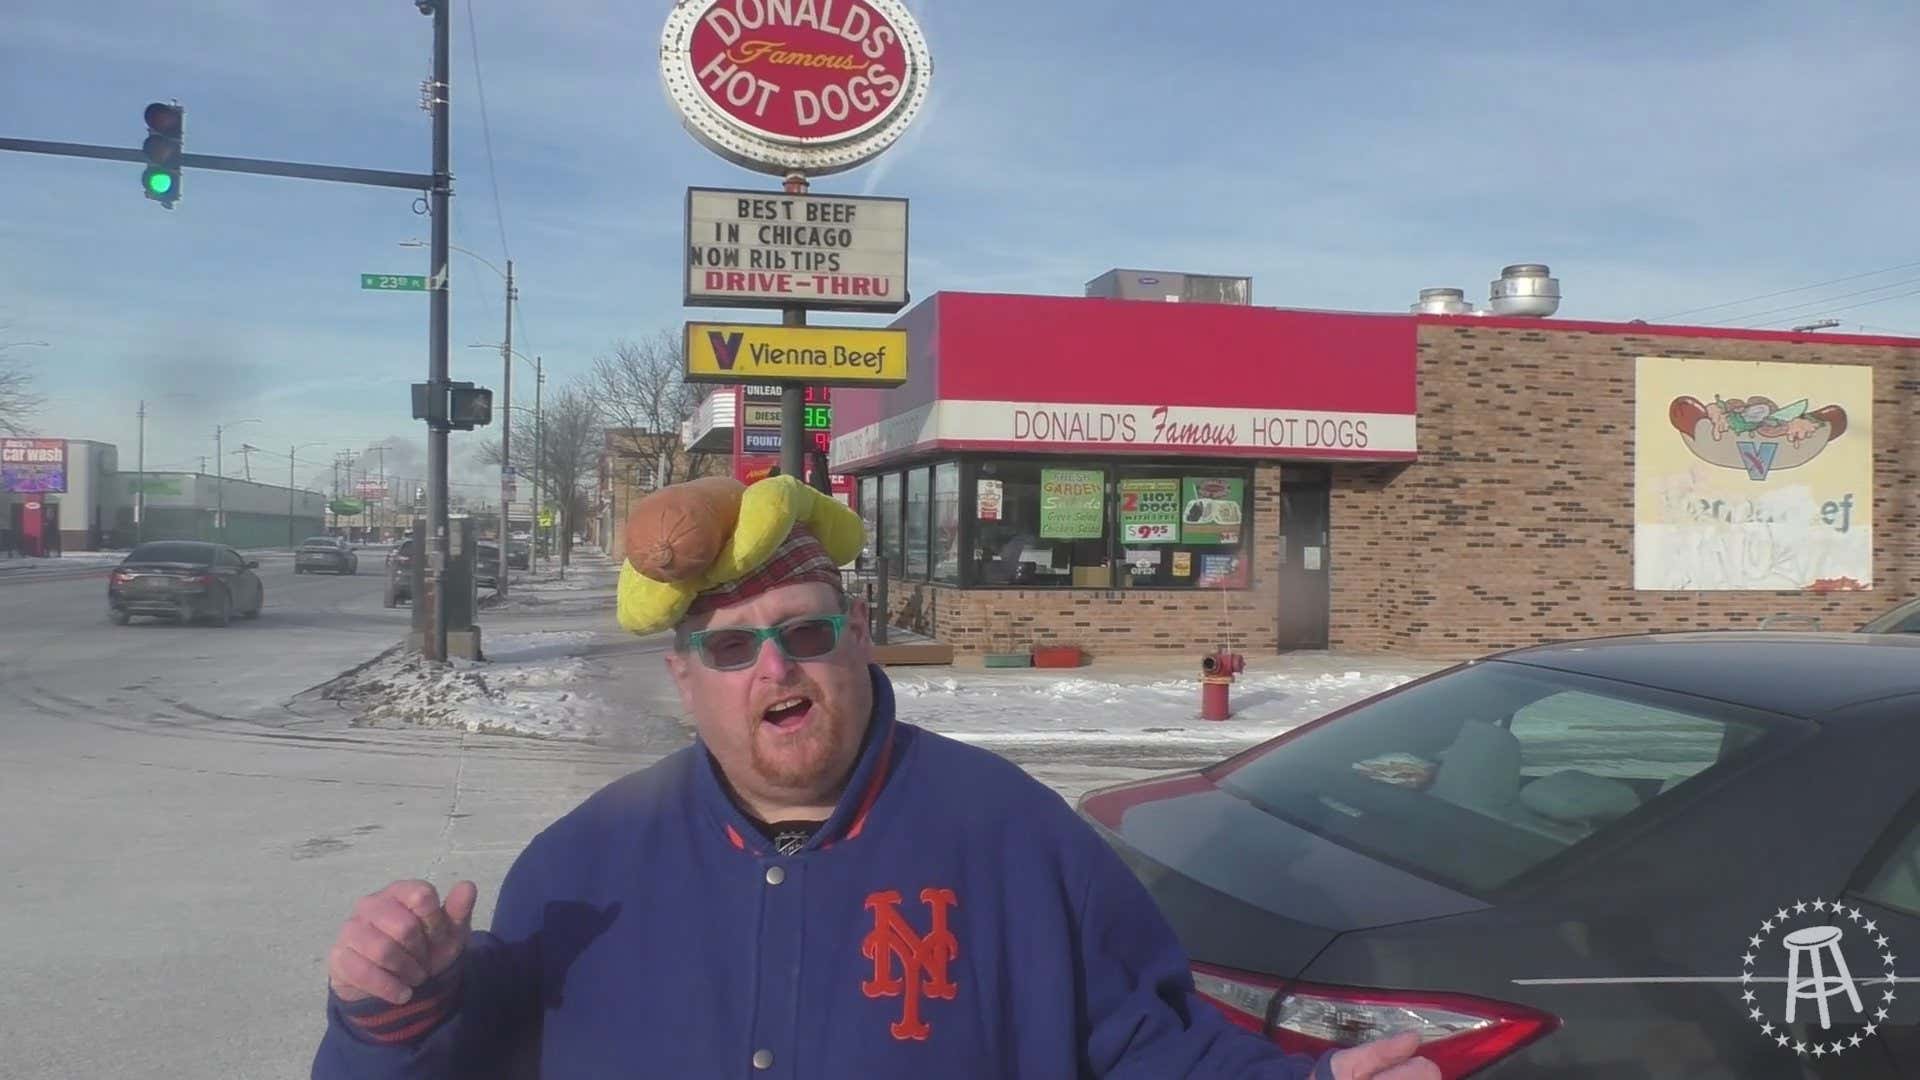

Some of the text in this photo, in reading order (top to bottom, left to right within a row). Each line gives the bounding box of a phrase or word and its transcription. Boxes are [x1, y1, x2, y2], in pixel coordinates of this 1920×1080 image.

[727, 40, 870, 70] Famous
[698, 52, 900, 126] HOT DOGS
[737, 198, 856, 223] BEST BEEF
[715, 222, 852, 248] IN CHICAGO
[691, 246, 739, 266] NOW
[705, 271, 889, 297] DRIVE-THRU
[750, 343, 827, 367] Vienna
[833, 345, 886, 374] Beef
[1014, 405, 1369, 448] DONALD'S Famous HOT DOGS
[1121, 492, 1174, 512] 2 HOT
[1140, 503, 1178, 512] DOGS
[862, 888, 958, 1041] NY
